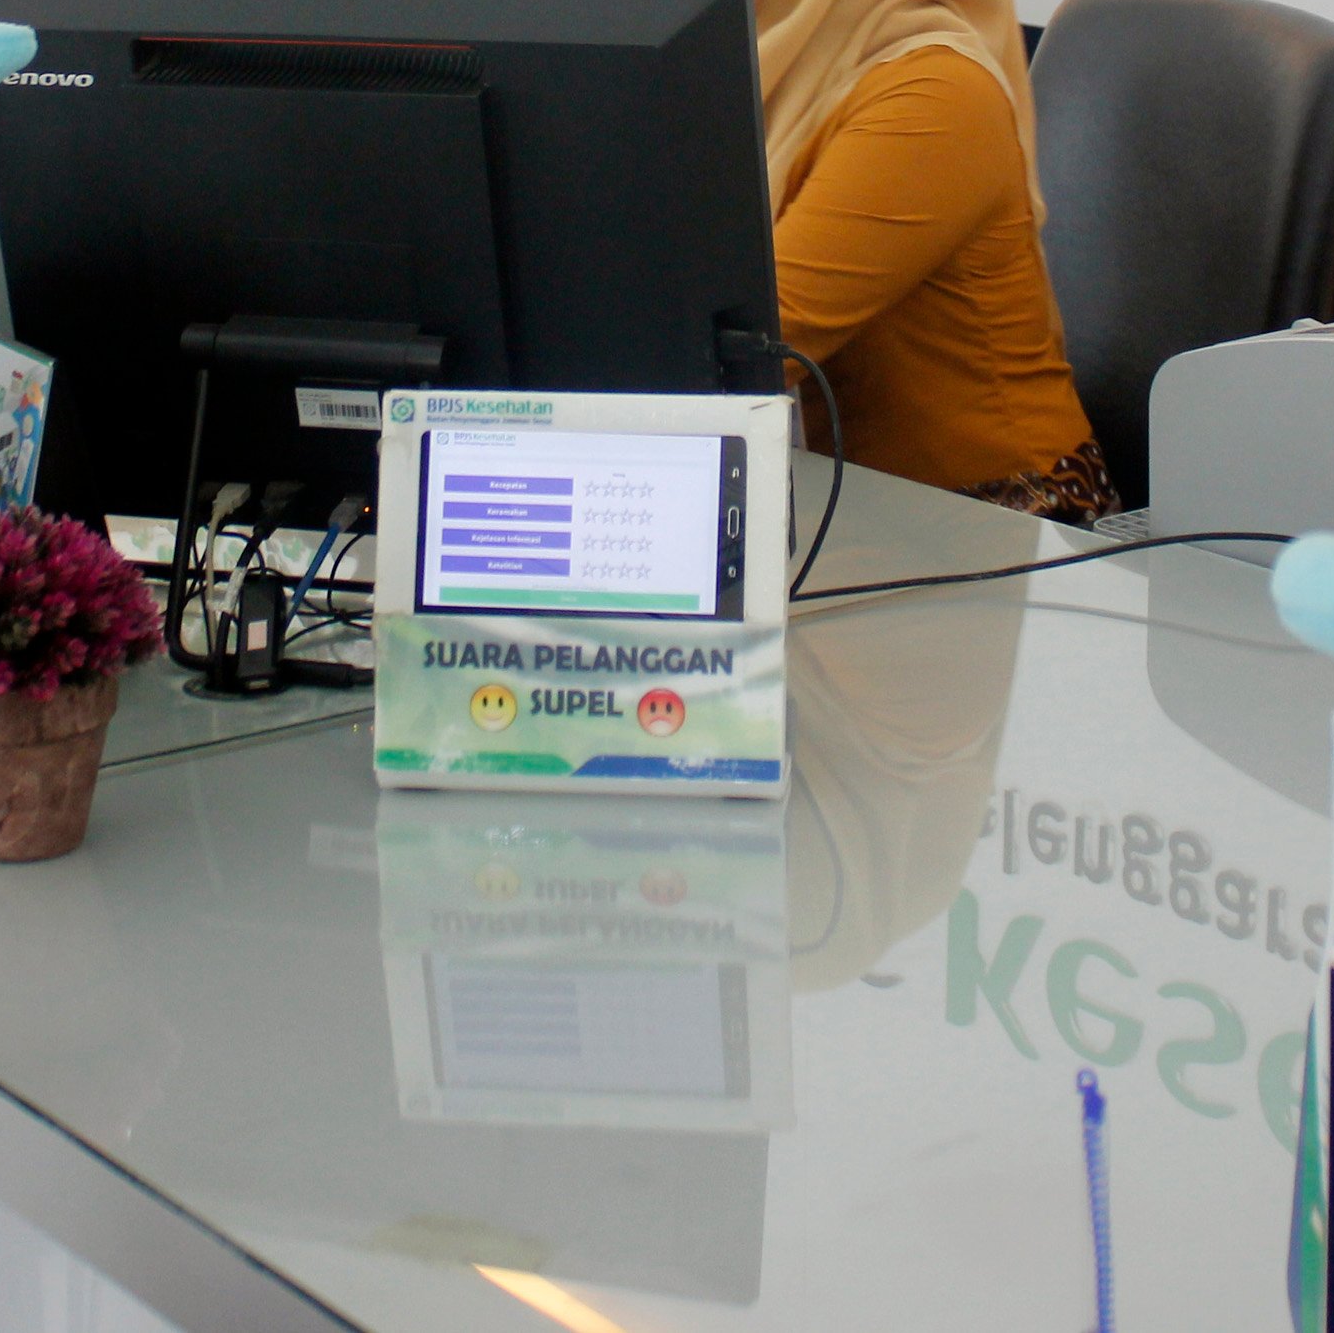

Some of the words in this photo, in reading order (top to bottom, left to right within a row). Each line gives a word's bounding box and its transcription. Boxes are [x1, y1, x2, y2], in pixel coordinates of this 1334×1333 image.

[3, 72, 95, 88] enovo
[427, 398, 464, 414] BPJS
[466, 399, 553, 415] Kesehatan
[423, 641, 525, 670] SUARA
[534, 643, 734, 676] PELANGGAN
[530, 689, 624, 718] SUPEL
